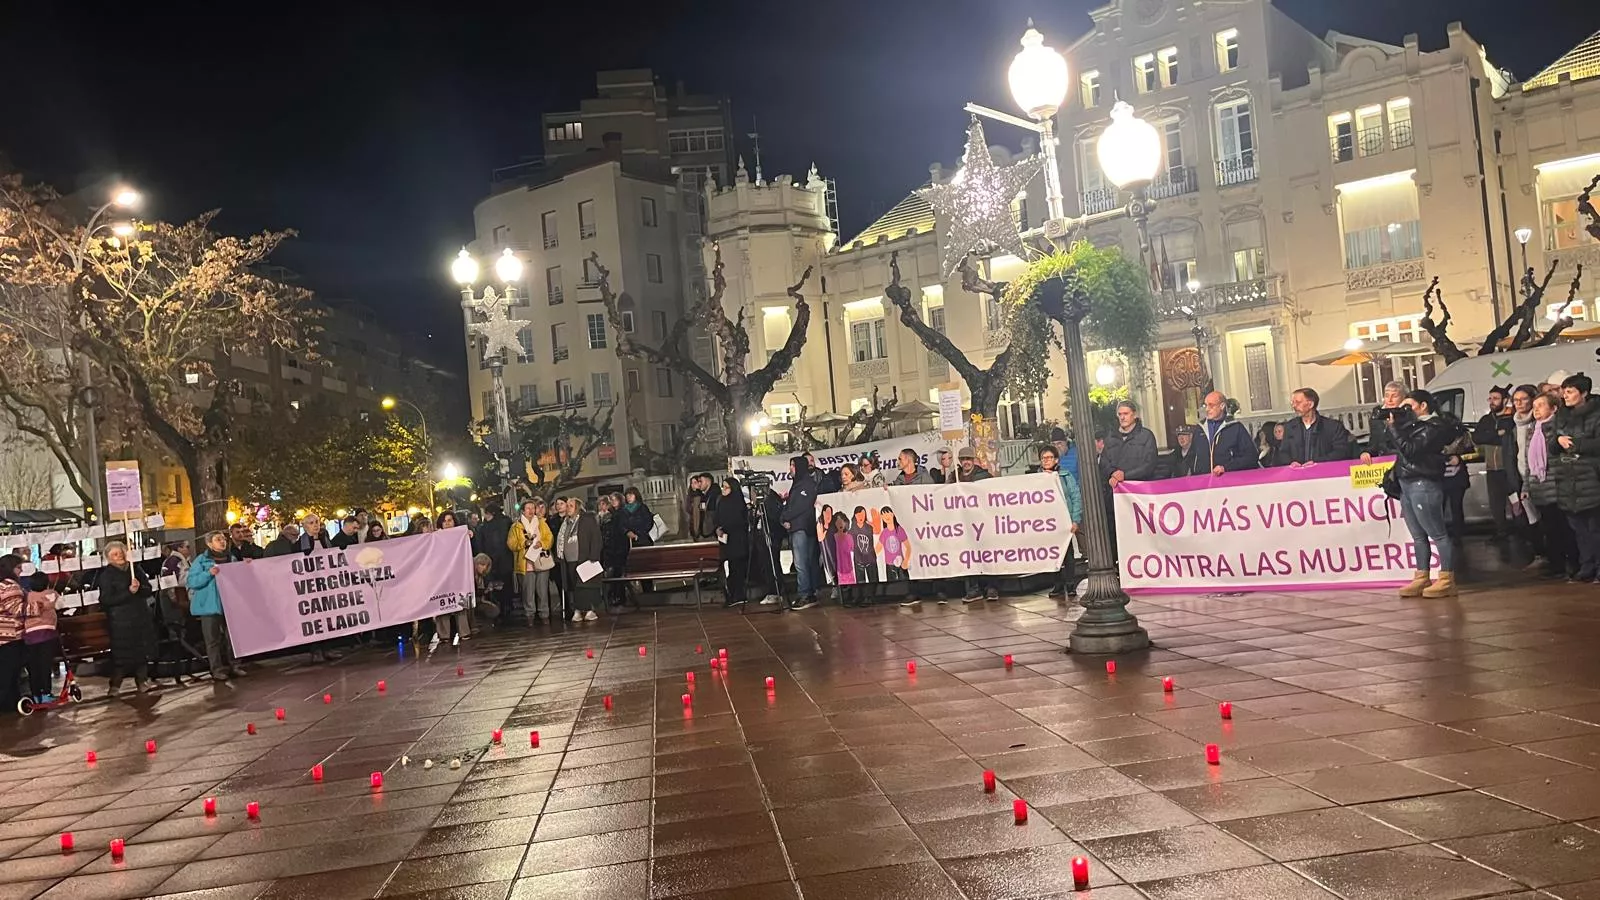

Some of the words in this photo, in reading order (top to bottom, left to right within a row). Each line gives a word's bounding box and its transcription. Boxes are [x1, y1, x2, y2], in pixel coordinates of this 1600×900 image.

[1355, 467, 1389, 479] AMNISTÍ
[912, 494, 934, 513] Ni
[944, 494, 978, 509] una
[988, 489, 1055, 507] menos
[1133, 502, 1184, 535] NO
[1194, 498, 1250, 533] MÁS
[1256, 494, 1405, 529] VIOLENCI
[915, 522, 963, 540] vivas
[972, 522, 984, 541] y
[995, 515, 1056, 534] libres
[291, 556, 325, 575] QUE
[328, 552, 348, 569] LA
[919, 552, 949, 567] nos
[959, 546, 1060, 569] queremos
[1127, 554, 1235, 579] CONTRA
[1240, 551, 1292, 576] LAS
[294, 565, 395, 595] VERGÜENZA
[298, 590, 364, 615] CAMBIE
[302, 619, 324, 636] DE
[326, 610, 370, 632] LADO
